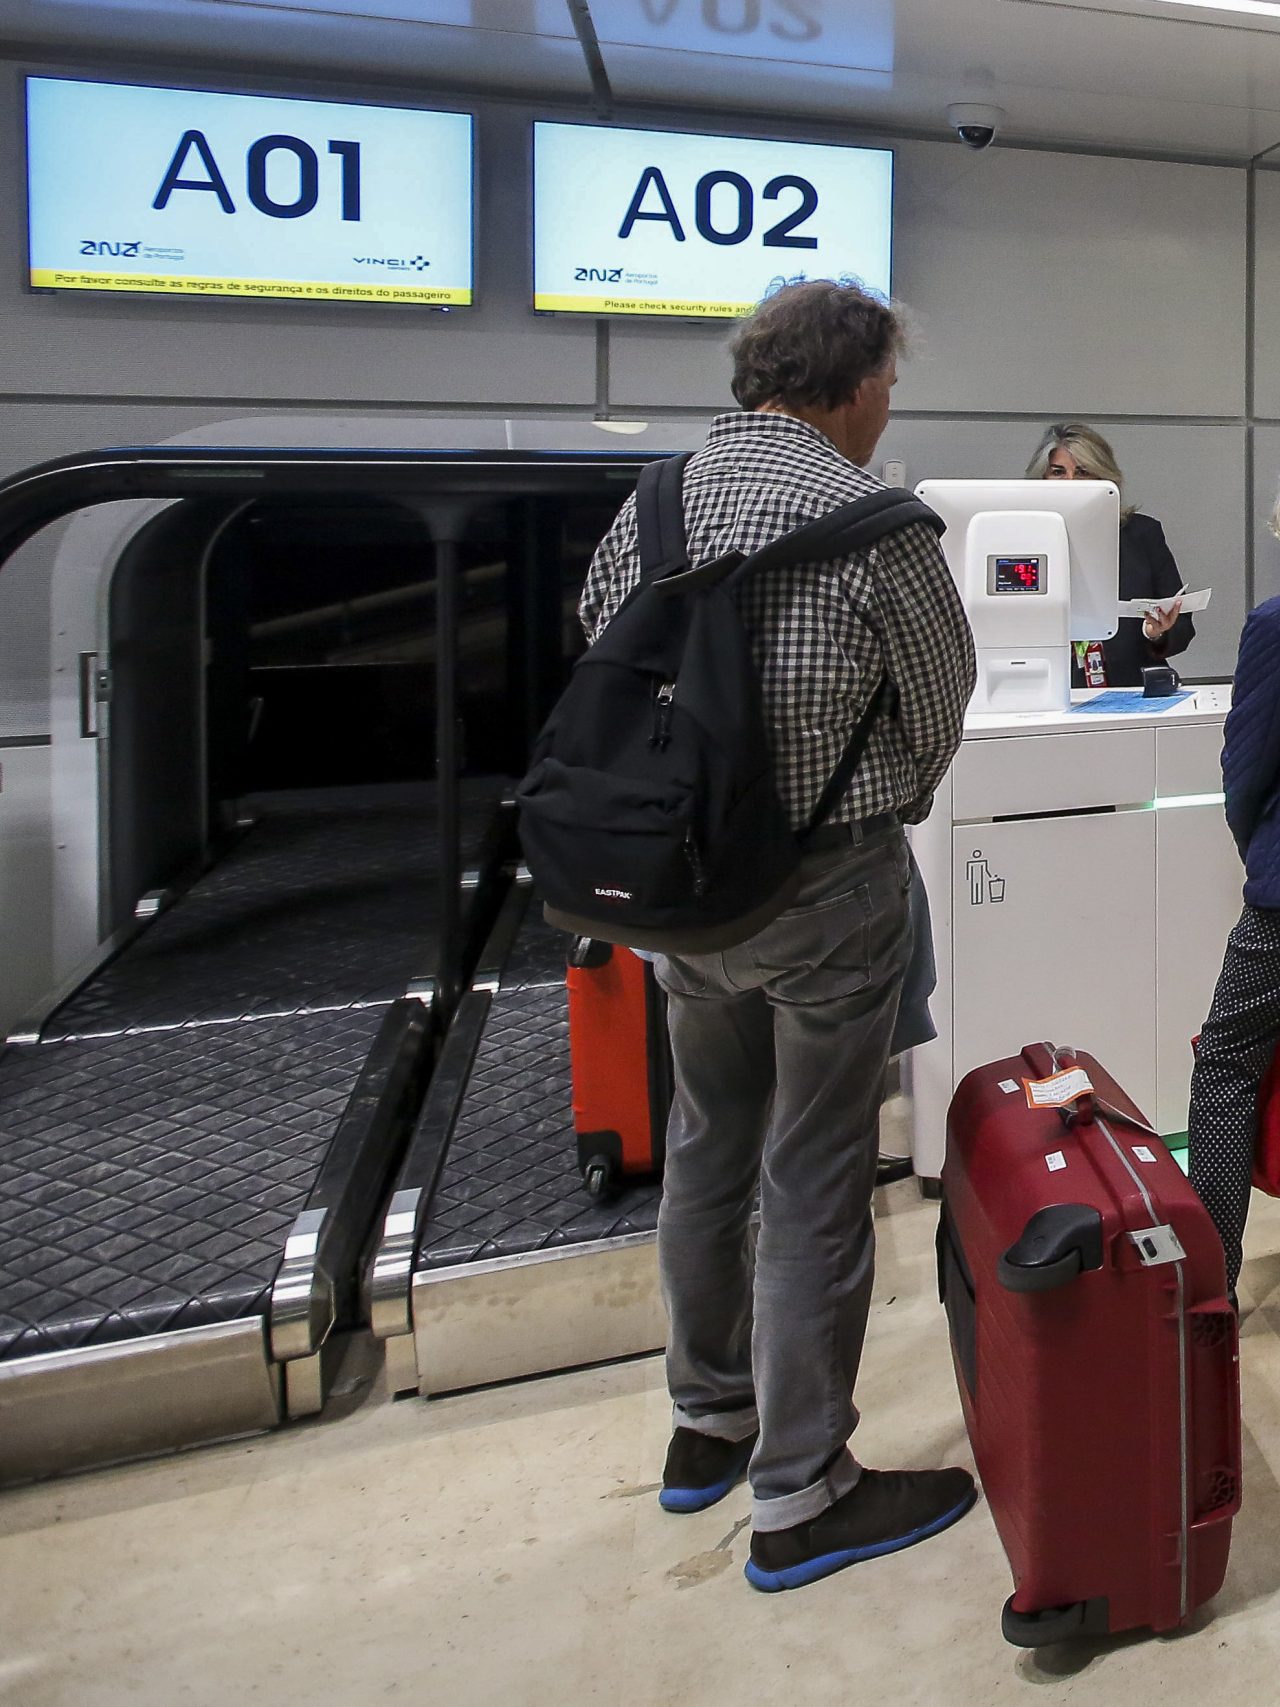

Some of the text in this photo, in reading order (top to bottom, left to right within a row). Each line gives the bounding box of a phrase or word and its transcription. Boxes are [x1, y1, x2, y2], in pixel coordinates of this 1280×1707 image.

[152, 130, 361, 222] A01
[618, 166, 819, 249] A02
[353, 257, 405, 266] VINCI
[114, 278, 166, 287] consulte
[187, 281, 223, 290] regras
[227, 282, 241, 290] de
[244, 284, 303, 293] segurança
[332, 287, 373, 296] direitos
[376, 289, 390, 297] do
[393, 291, 451, 299] passageiro
[604, 300, 636, 309] Please
[639, 302, 667, 310] check
[670, 303, 706, 313] security
[595, 888, 631, 900] EASTPAK
